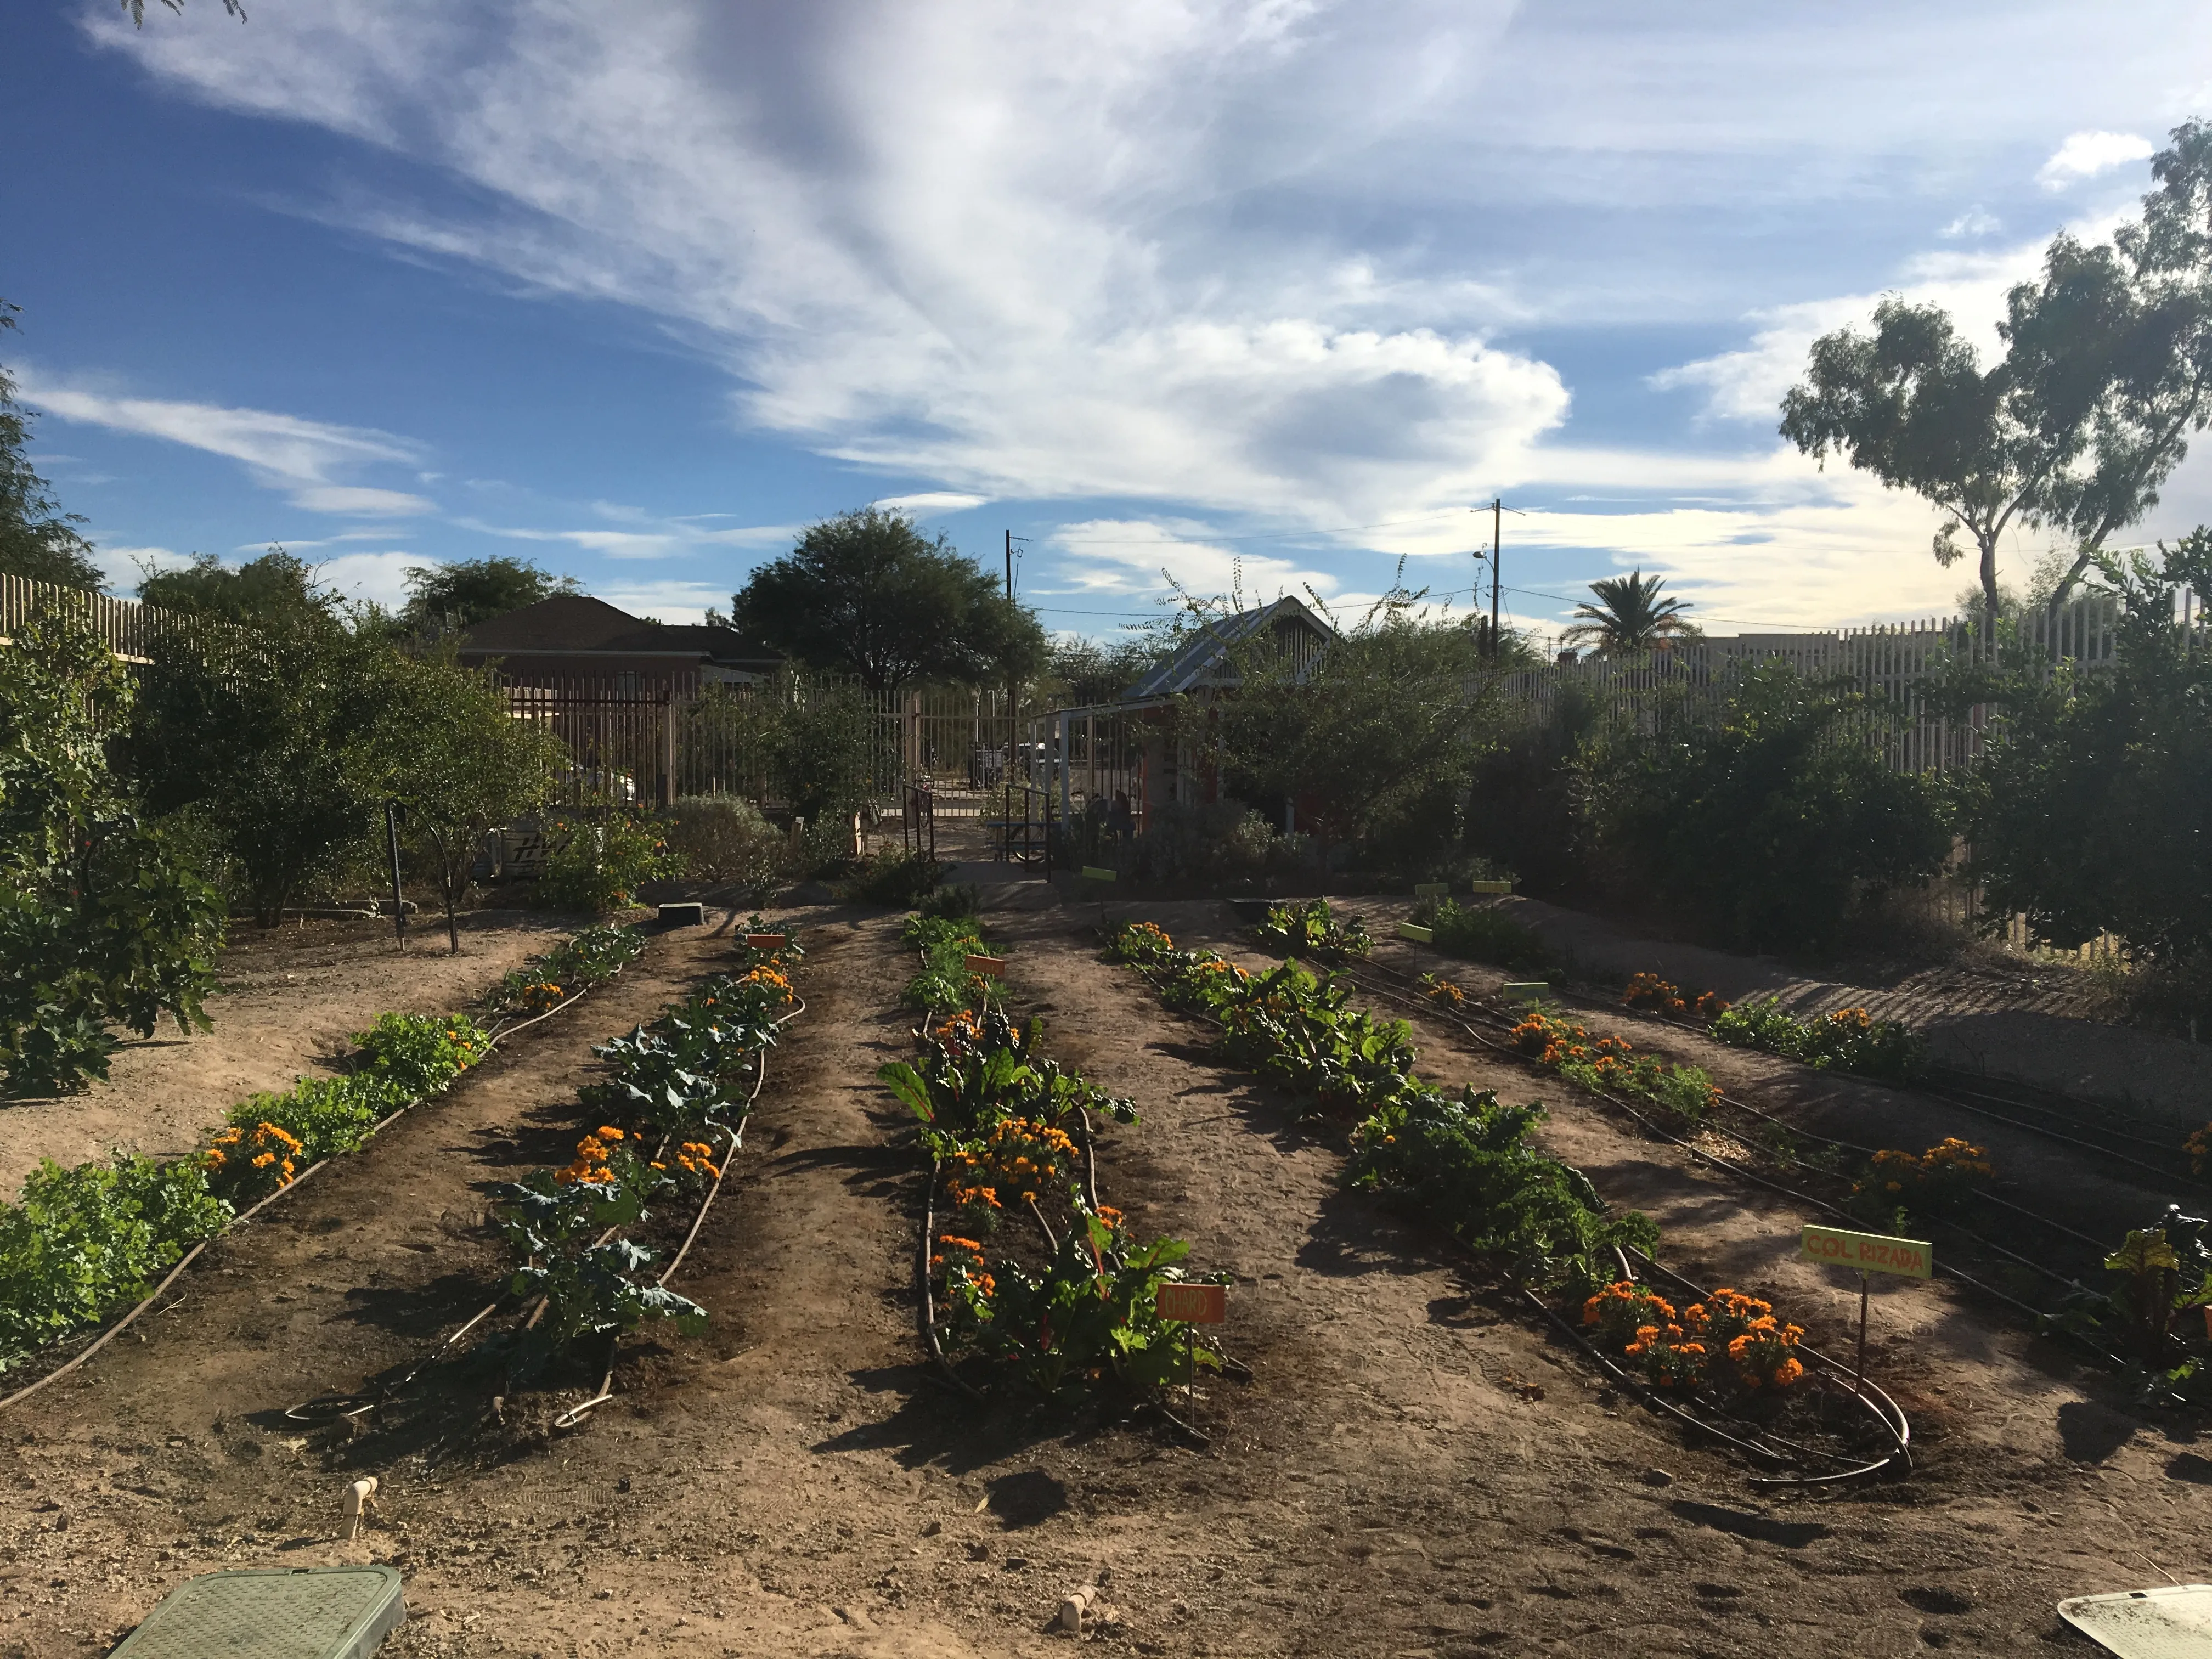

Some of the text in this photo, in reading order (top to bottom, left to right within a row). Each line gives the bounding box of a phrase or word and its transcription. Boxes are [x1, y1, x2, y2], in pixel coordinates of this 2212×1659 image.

[1807, 1235, 1923, 1272] COL RIZADA
[1165, 1288, 1207, 1316] CHARD
